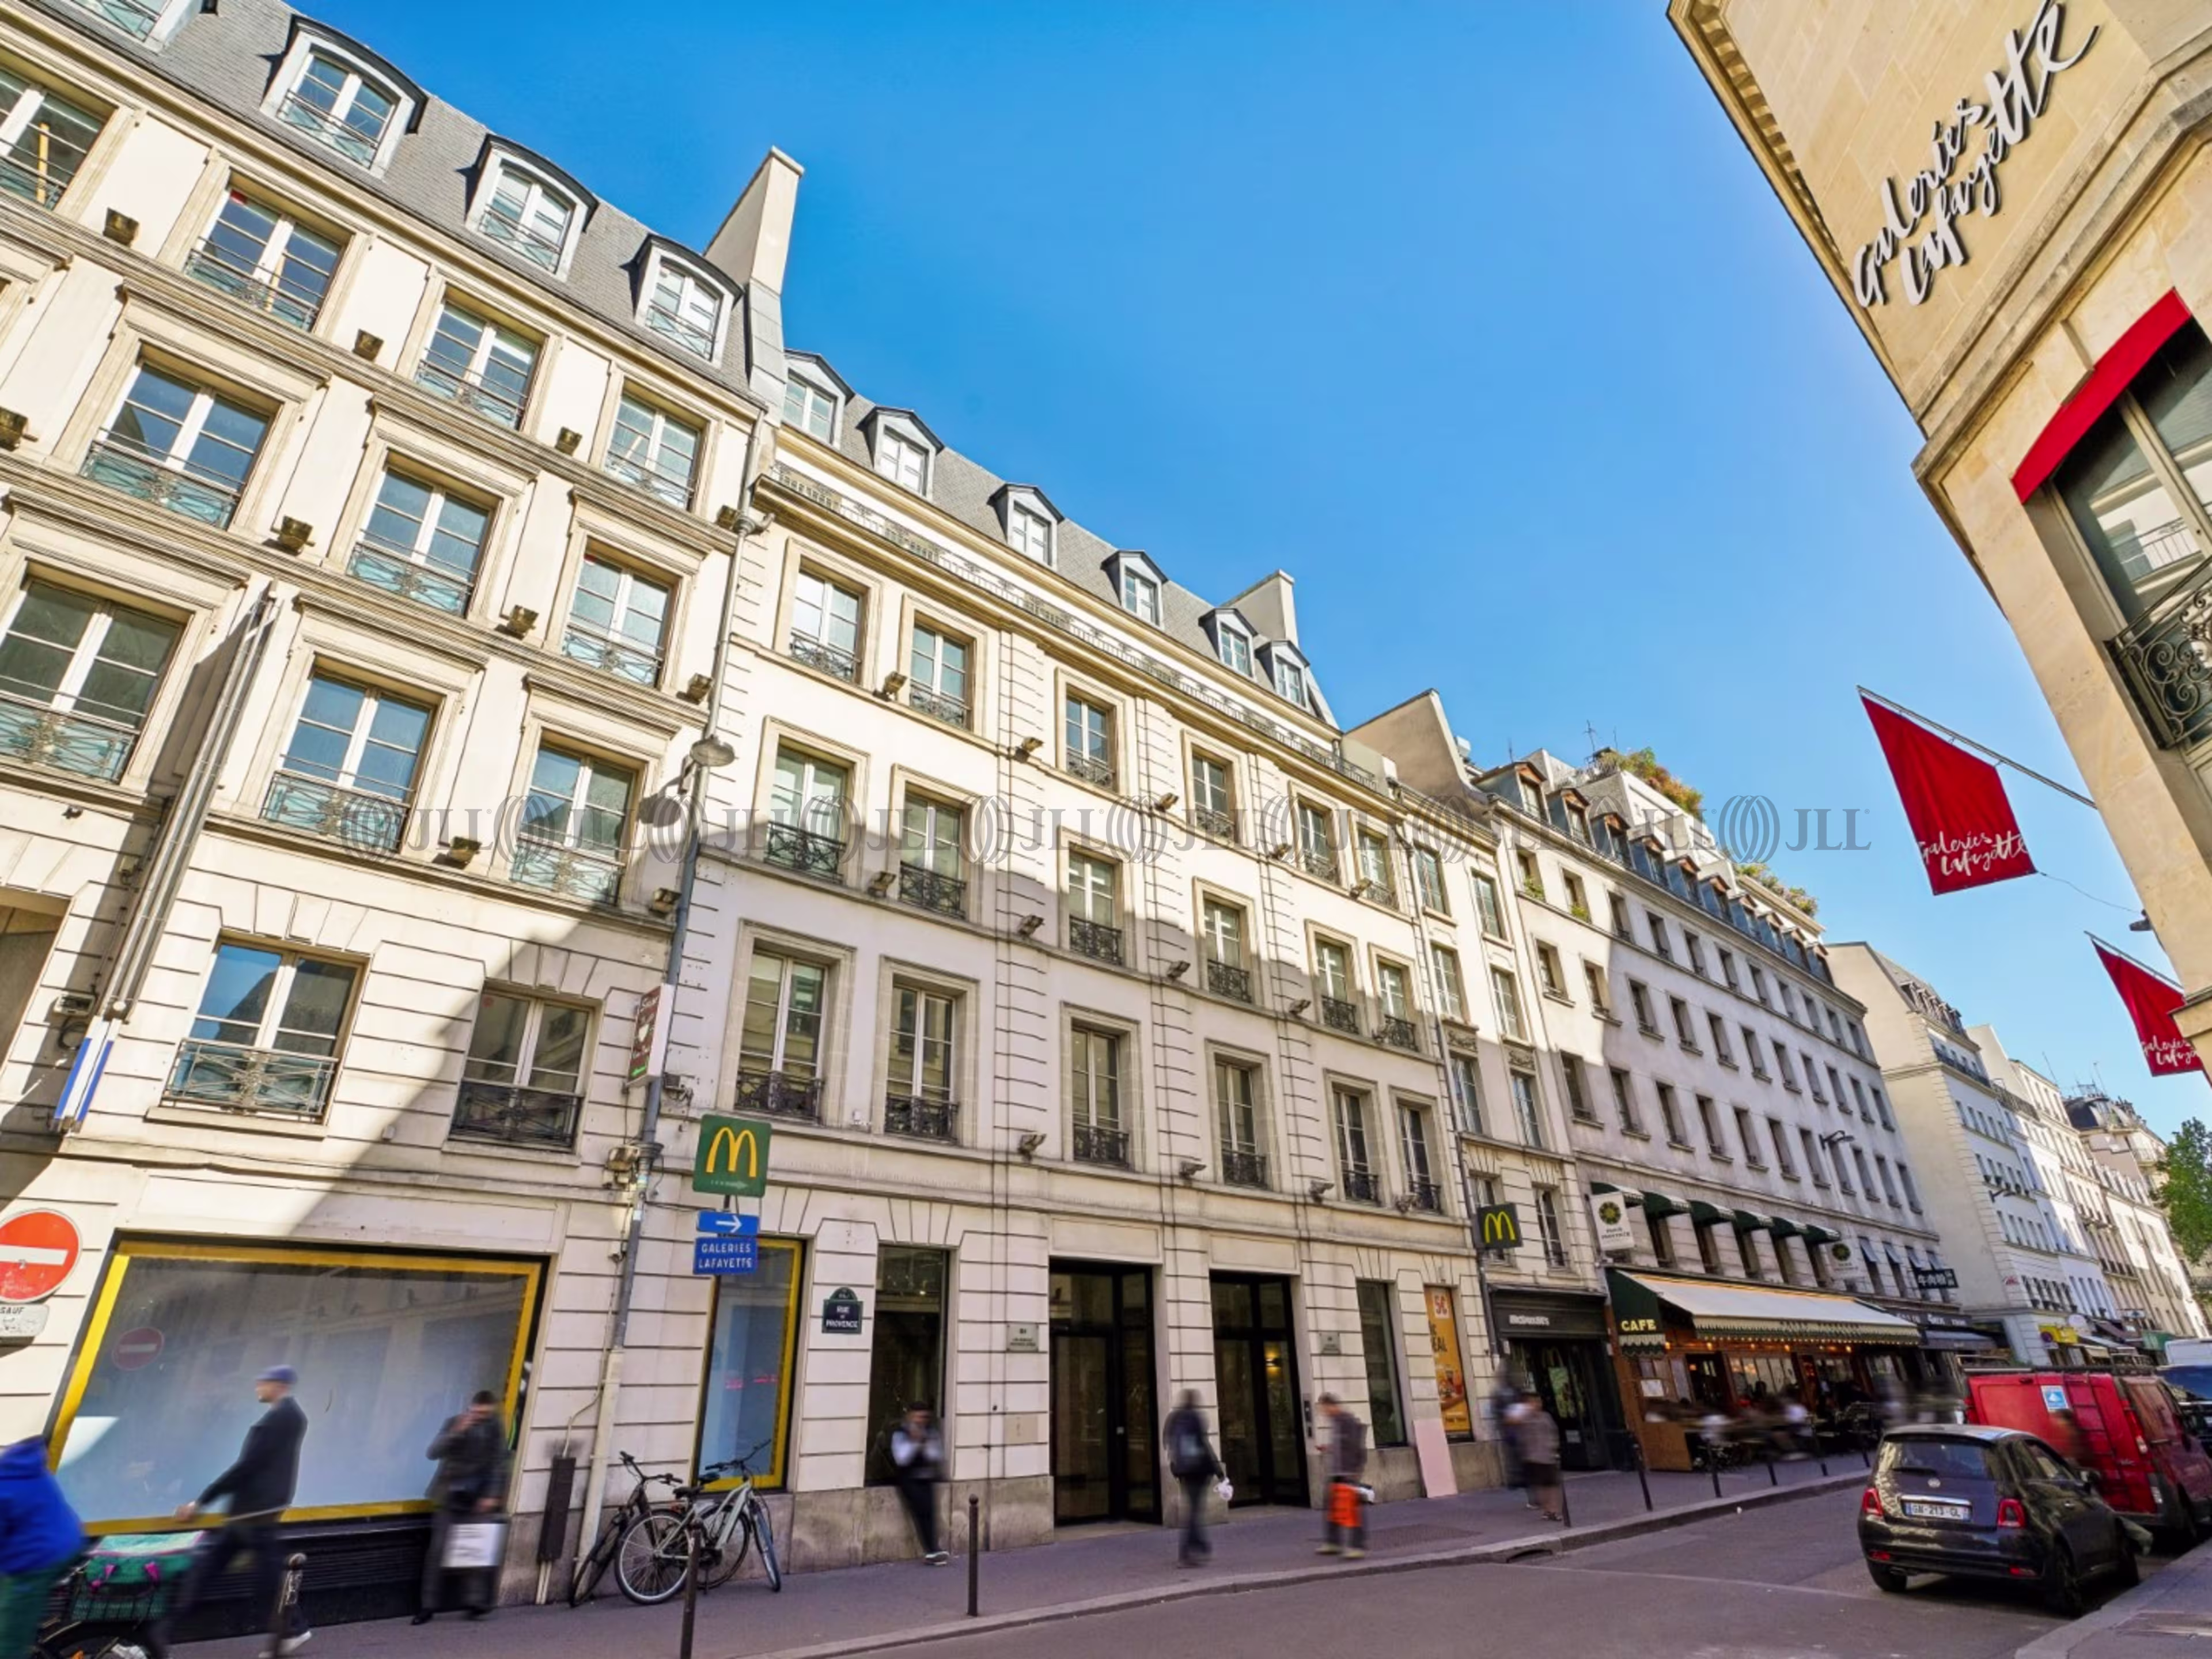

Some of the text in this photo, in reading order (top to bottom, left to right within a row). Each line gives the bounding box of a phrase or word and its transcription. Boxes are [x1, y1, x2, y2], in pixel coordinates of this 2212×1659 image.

[701, 1243, 751, 1253] GALERIES
[698, 1257, 752, 1268] LAFAYETTE
[1621, 1319, 1657, 1331] CAFE
